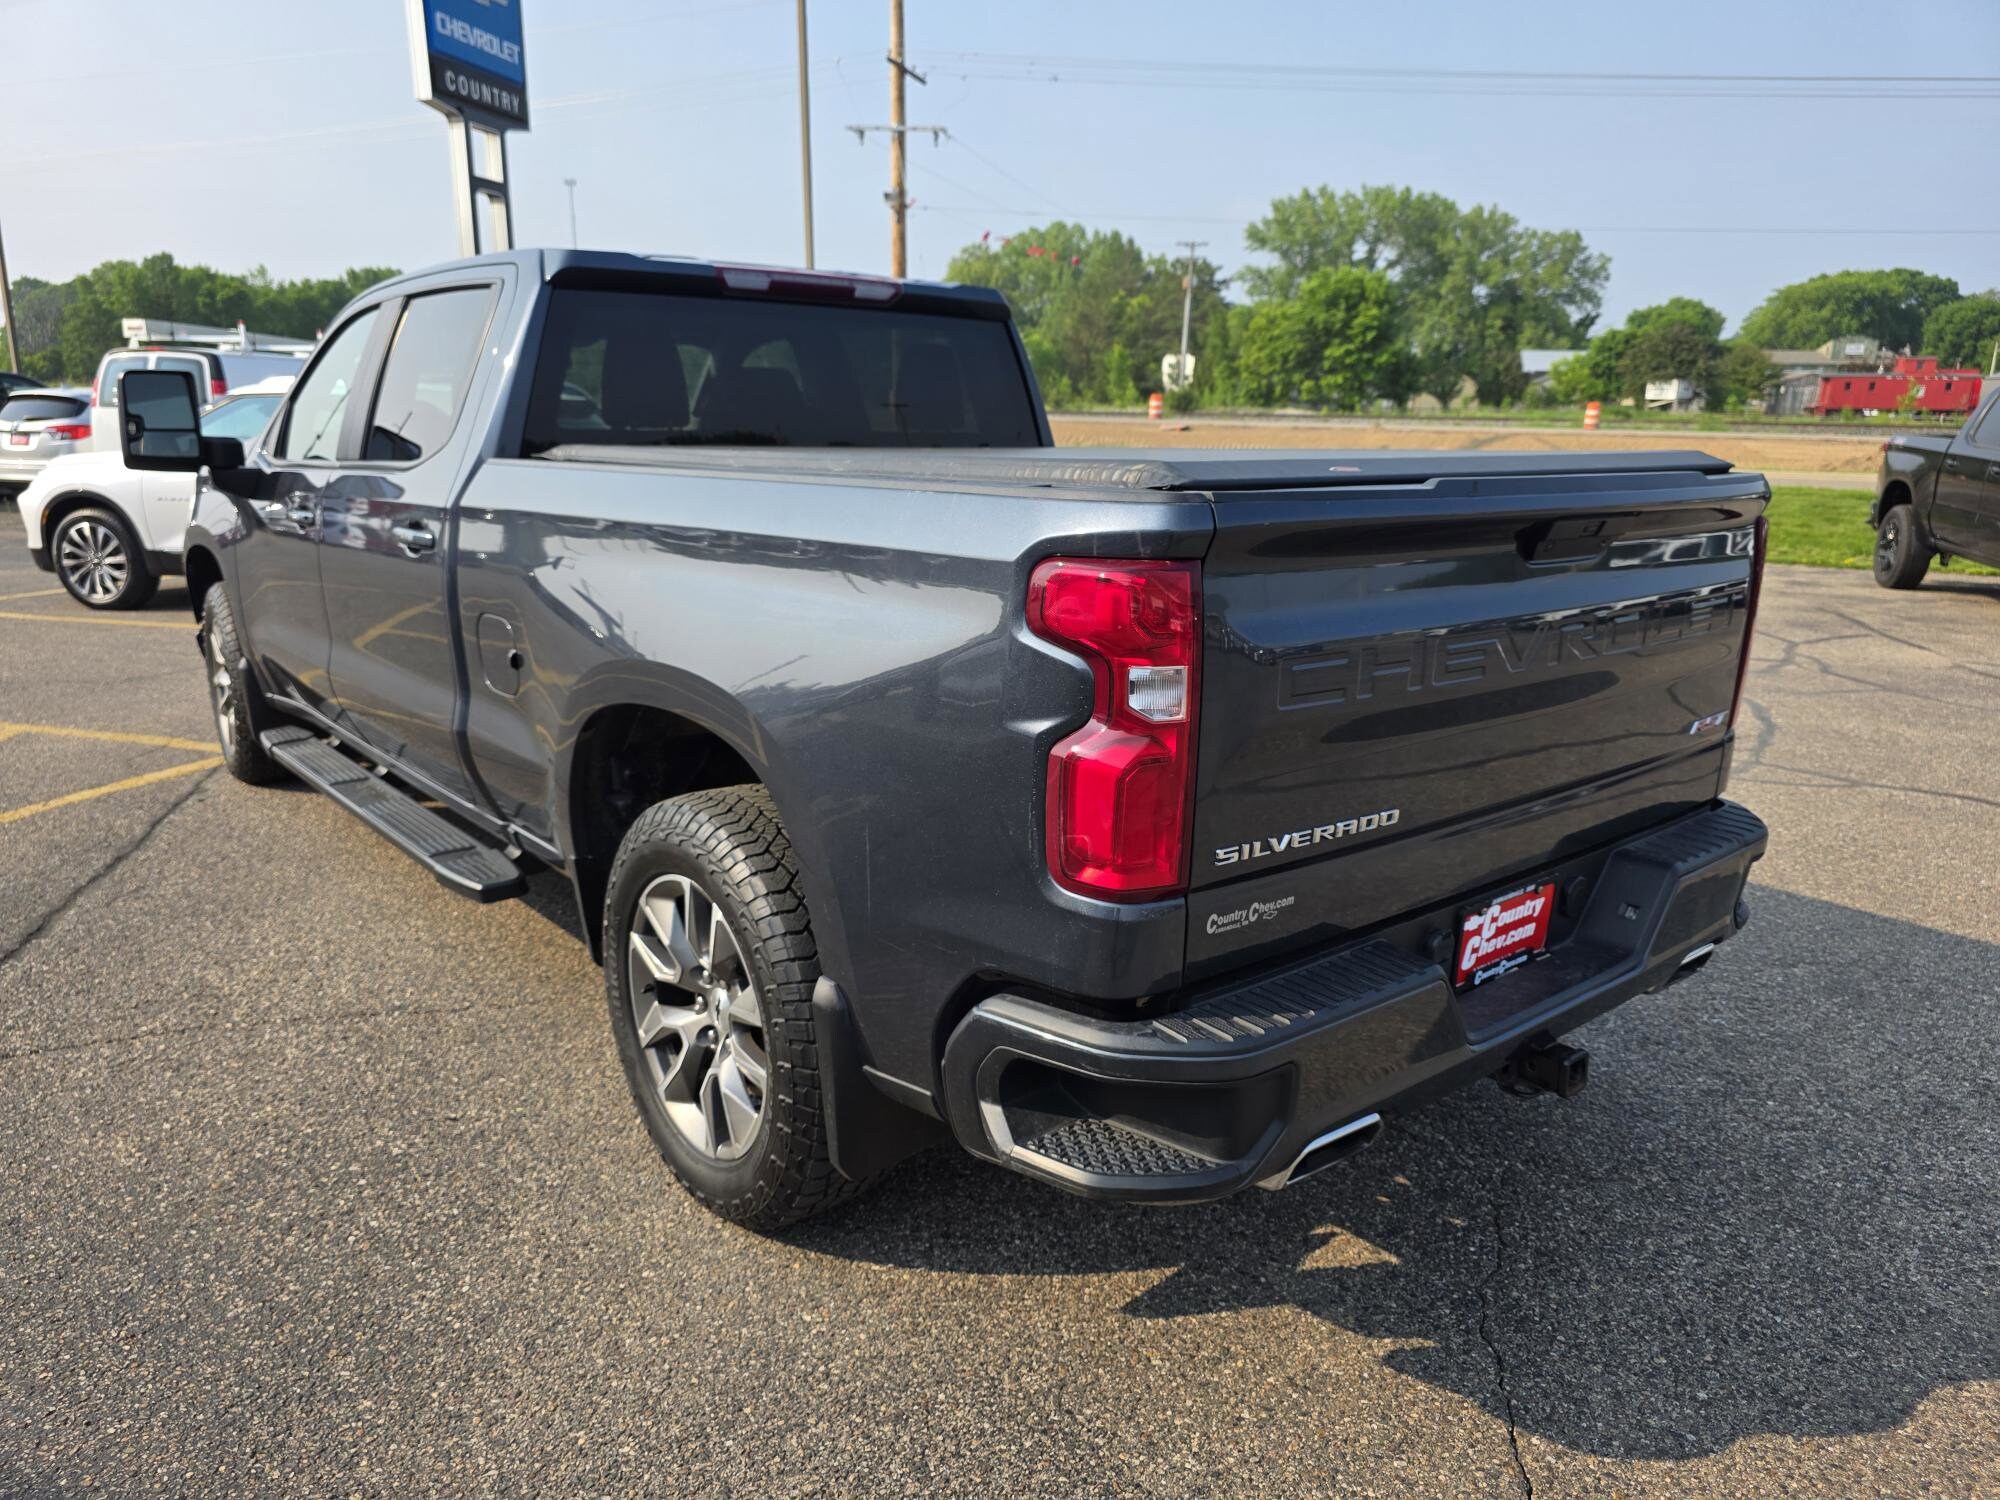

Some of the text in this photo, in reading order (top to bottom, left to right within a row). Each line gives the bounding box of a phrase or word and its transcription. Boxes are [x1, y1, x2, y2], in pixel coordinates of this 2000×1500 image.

[435, 10, 520, 65] CHEVROLET
[444, 69, 520, 114] COUNTRY
[1277, 589, 1748, 712] CHEVROLET
[1214, 808, 1400, 866] SILVERADO
[1482, 897, 1546, 940] Country
[1461, 922, 1537, 971] Chev.com
